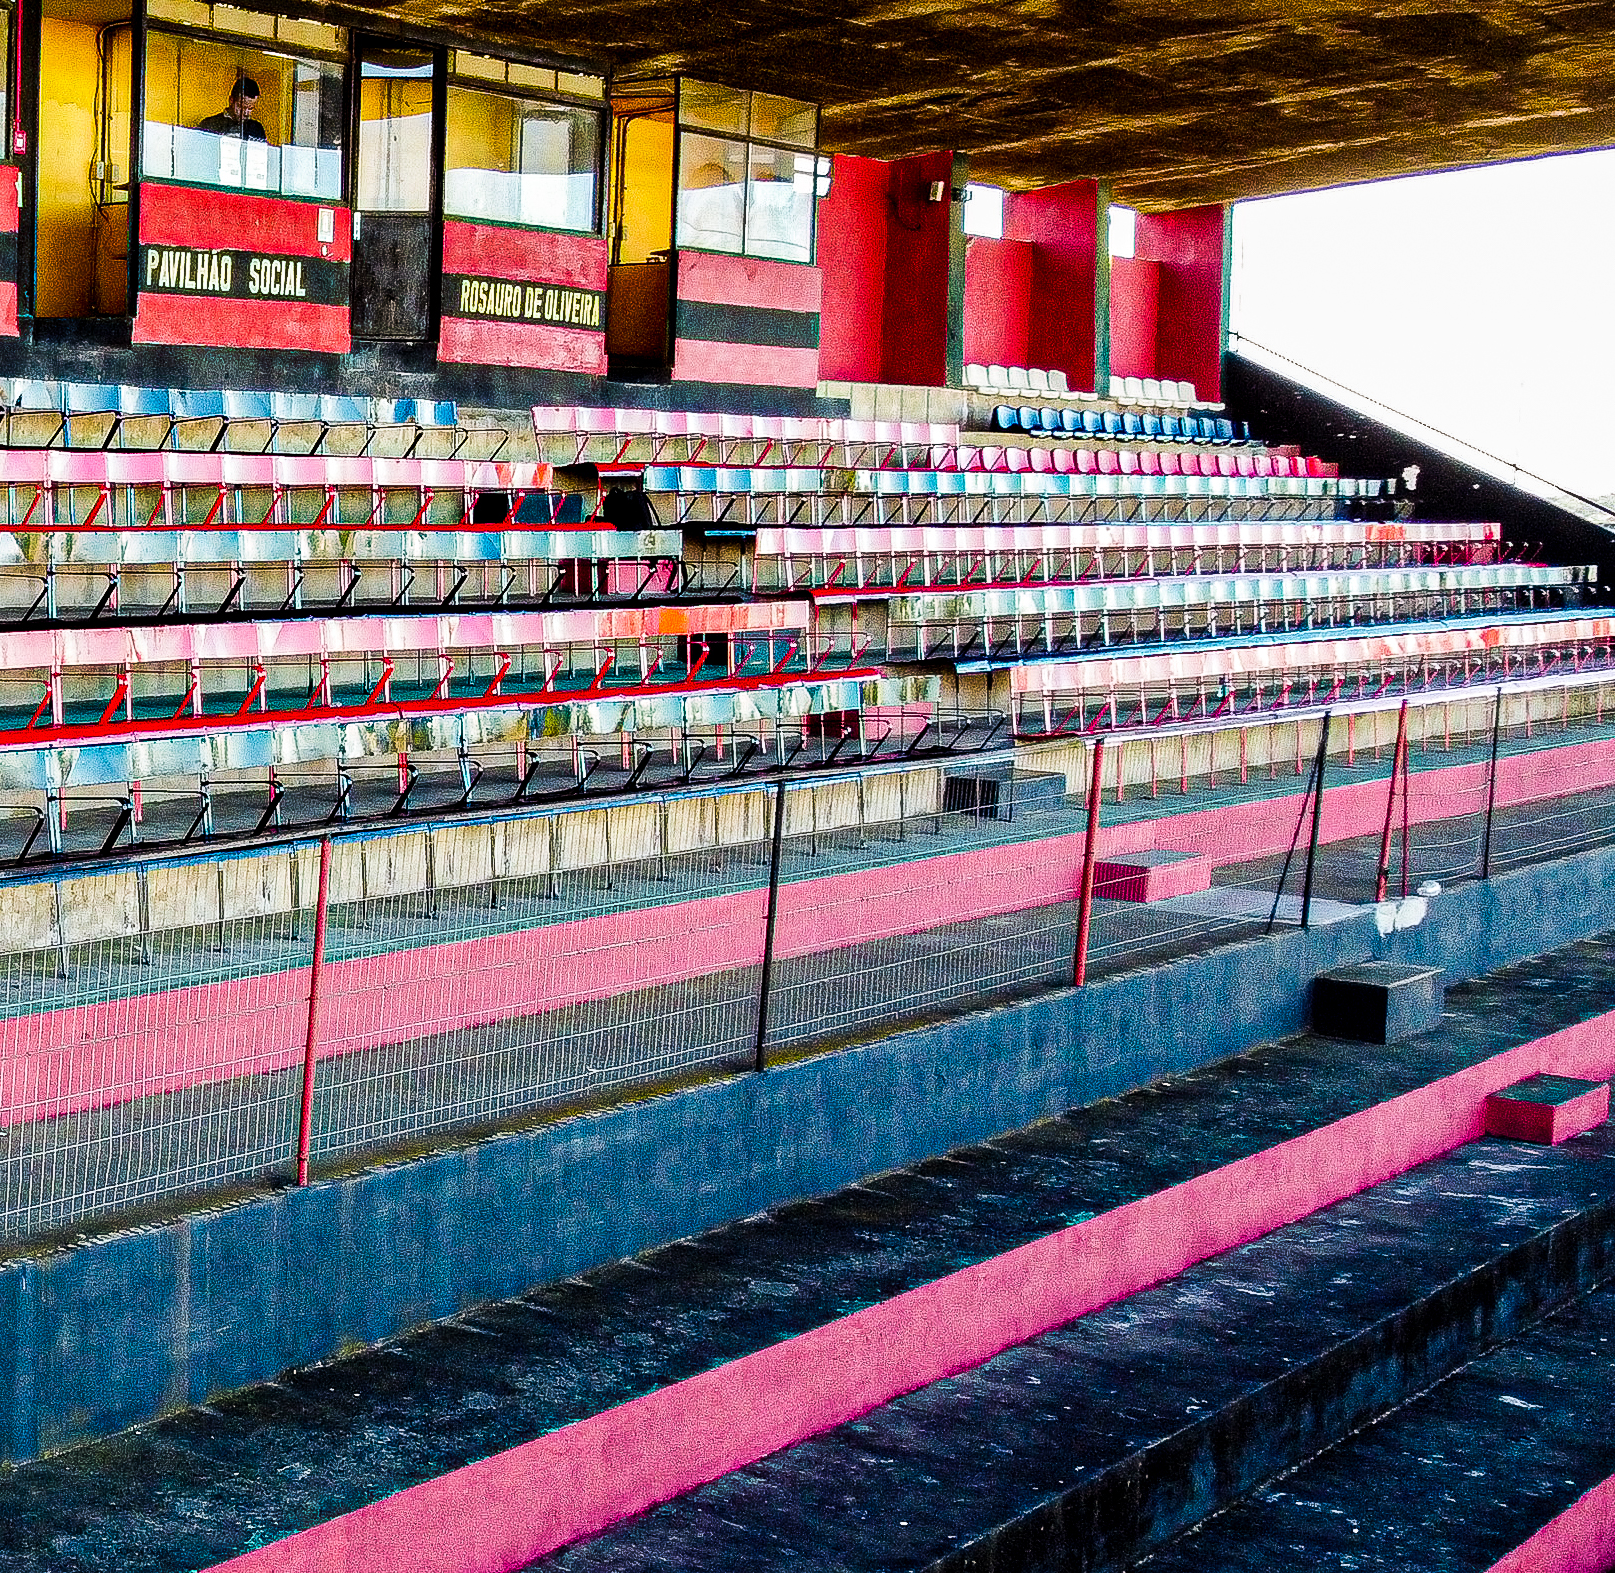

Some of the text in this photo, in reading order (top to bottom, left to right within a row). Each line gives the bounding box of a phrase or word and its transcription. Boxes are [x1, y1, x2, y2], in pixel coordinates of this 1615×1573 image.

[146, 249, 306, 297] PAVILHÃO SOCIAL
[460, 279, 600, 327] ROSAURO DE OLIVEIRA
